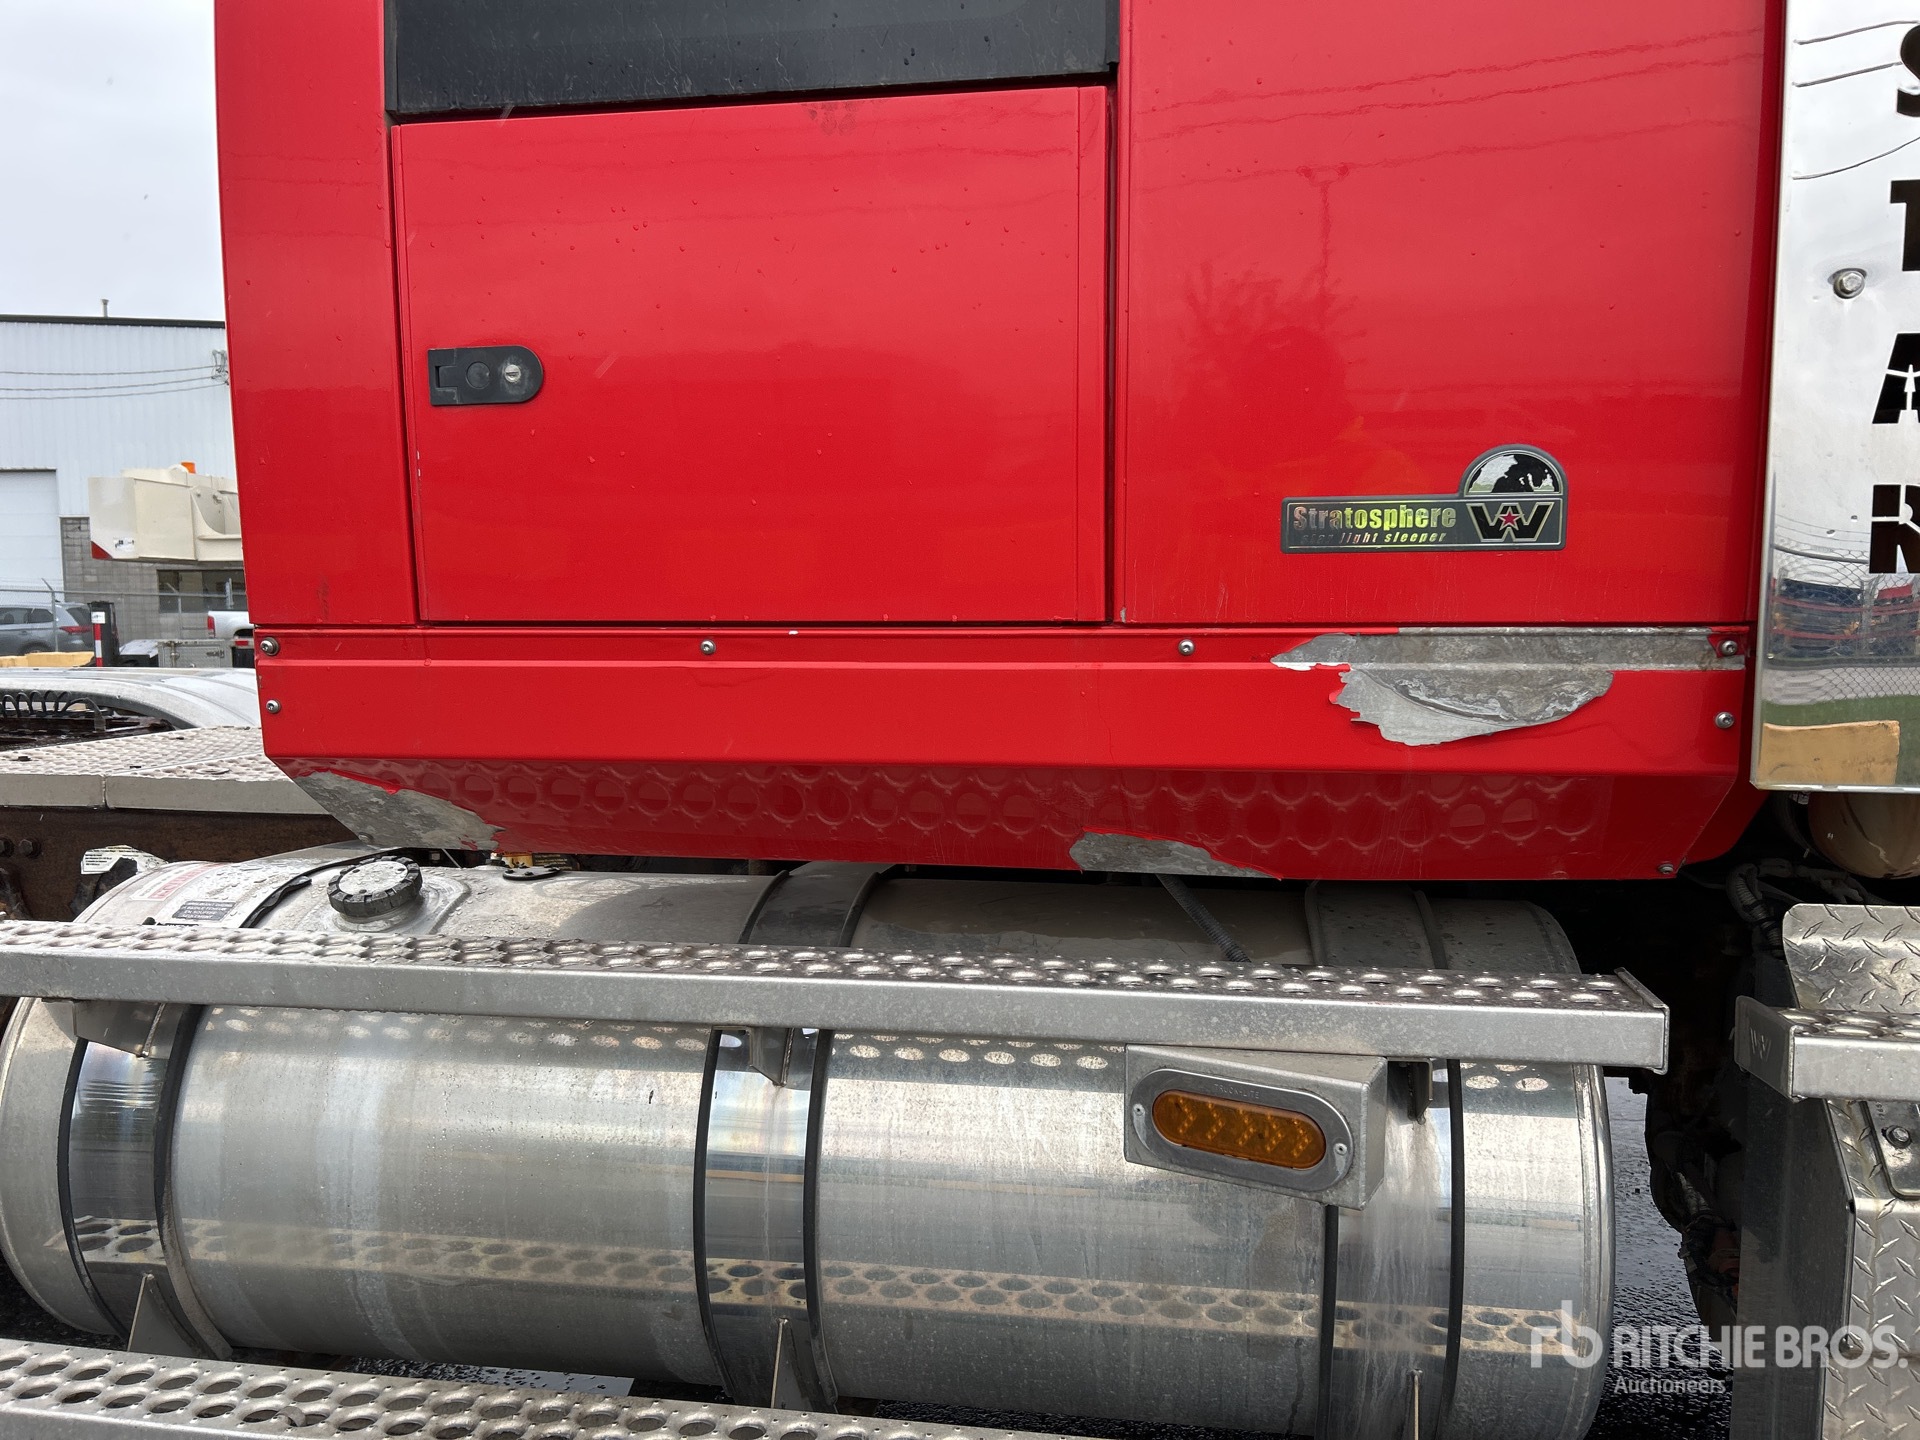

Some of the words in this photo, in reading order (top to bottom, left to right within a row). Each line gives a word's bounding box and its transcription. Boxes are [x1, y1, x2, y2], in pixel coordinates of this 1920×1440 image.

[1293, 504, 1457, 531] Stratosphere
[1339, 532, 1379, 545] light
[1383, 531, 1447, 544] sleeper
